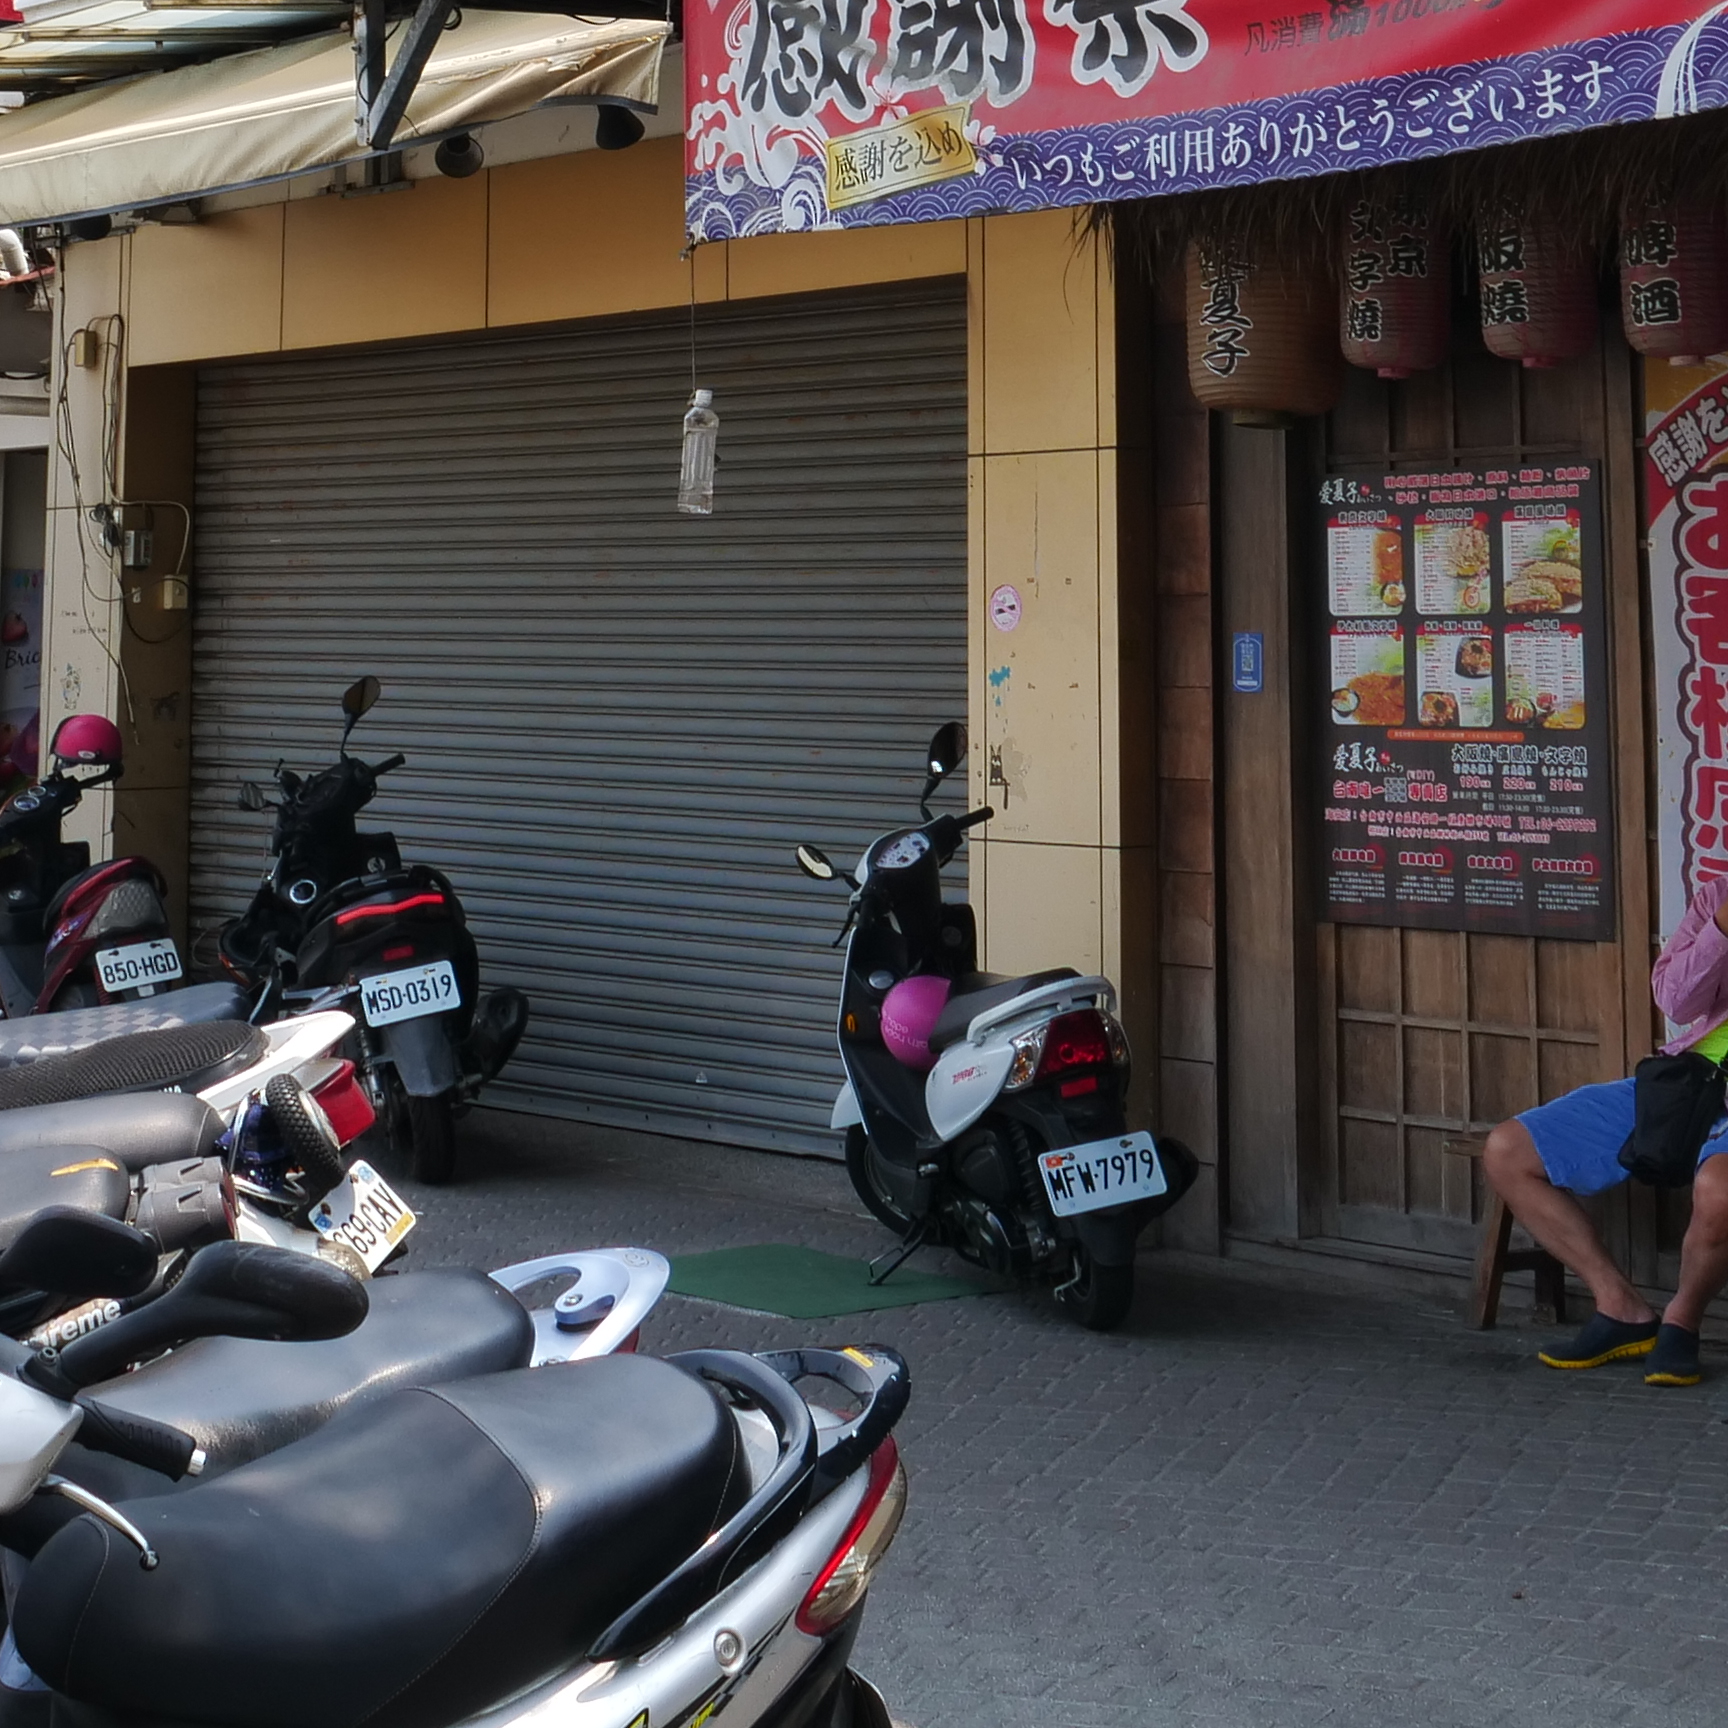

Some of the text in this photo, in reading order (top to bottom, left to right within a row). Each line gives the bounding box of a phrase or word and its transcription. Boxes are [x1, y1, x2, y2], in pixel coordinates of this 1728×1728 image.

[1013, 60, 1615, 189] いつもご利用ありがとうございます
[835, 123, 963, 191] 感謝を込め
[368, 973, 453, 1016] MSD-0319
[1047, 1148, 1154, 1201] MFW-7979
